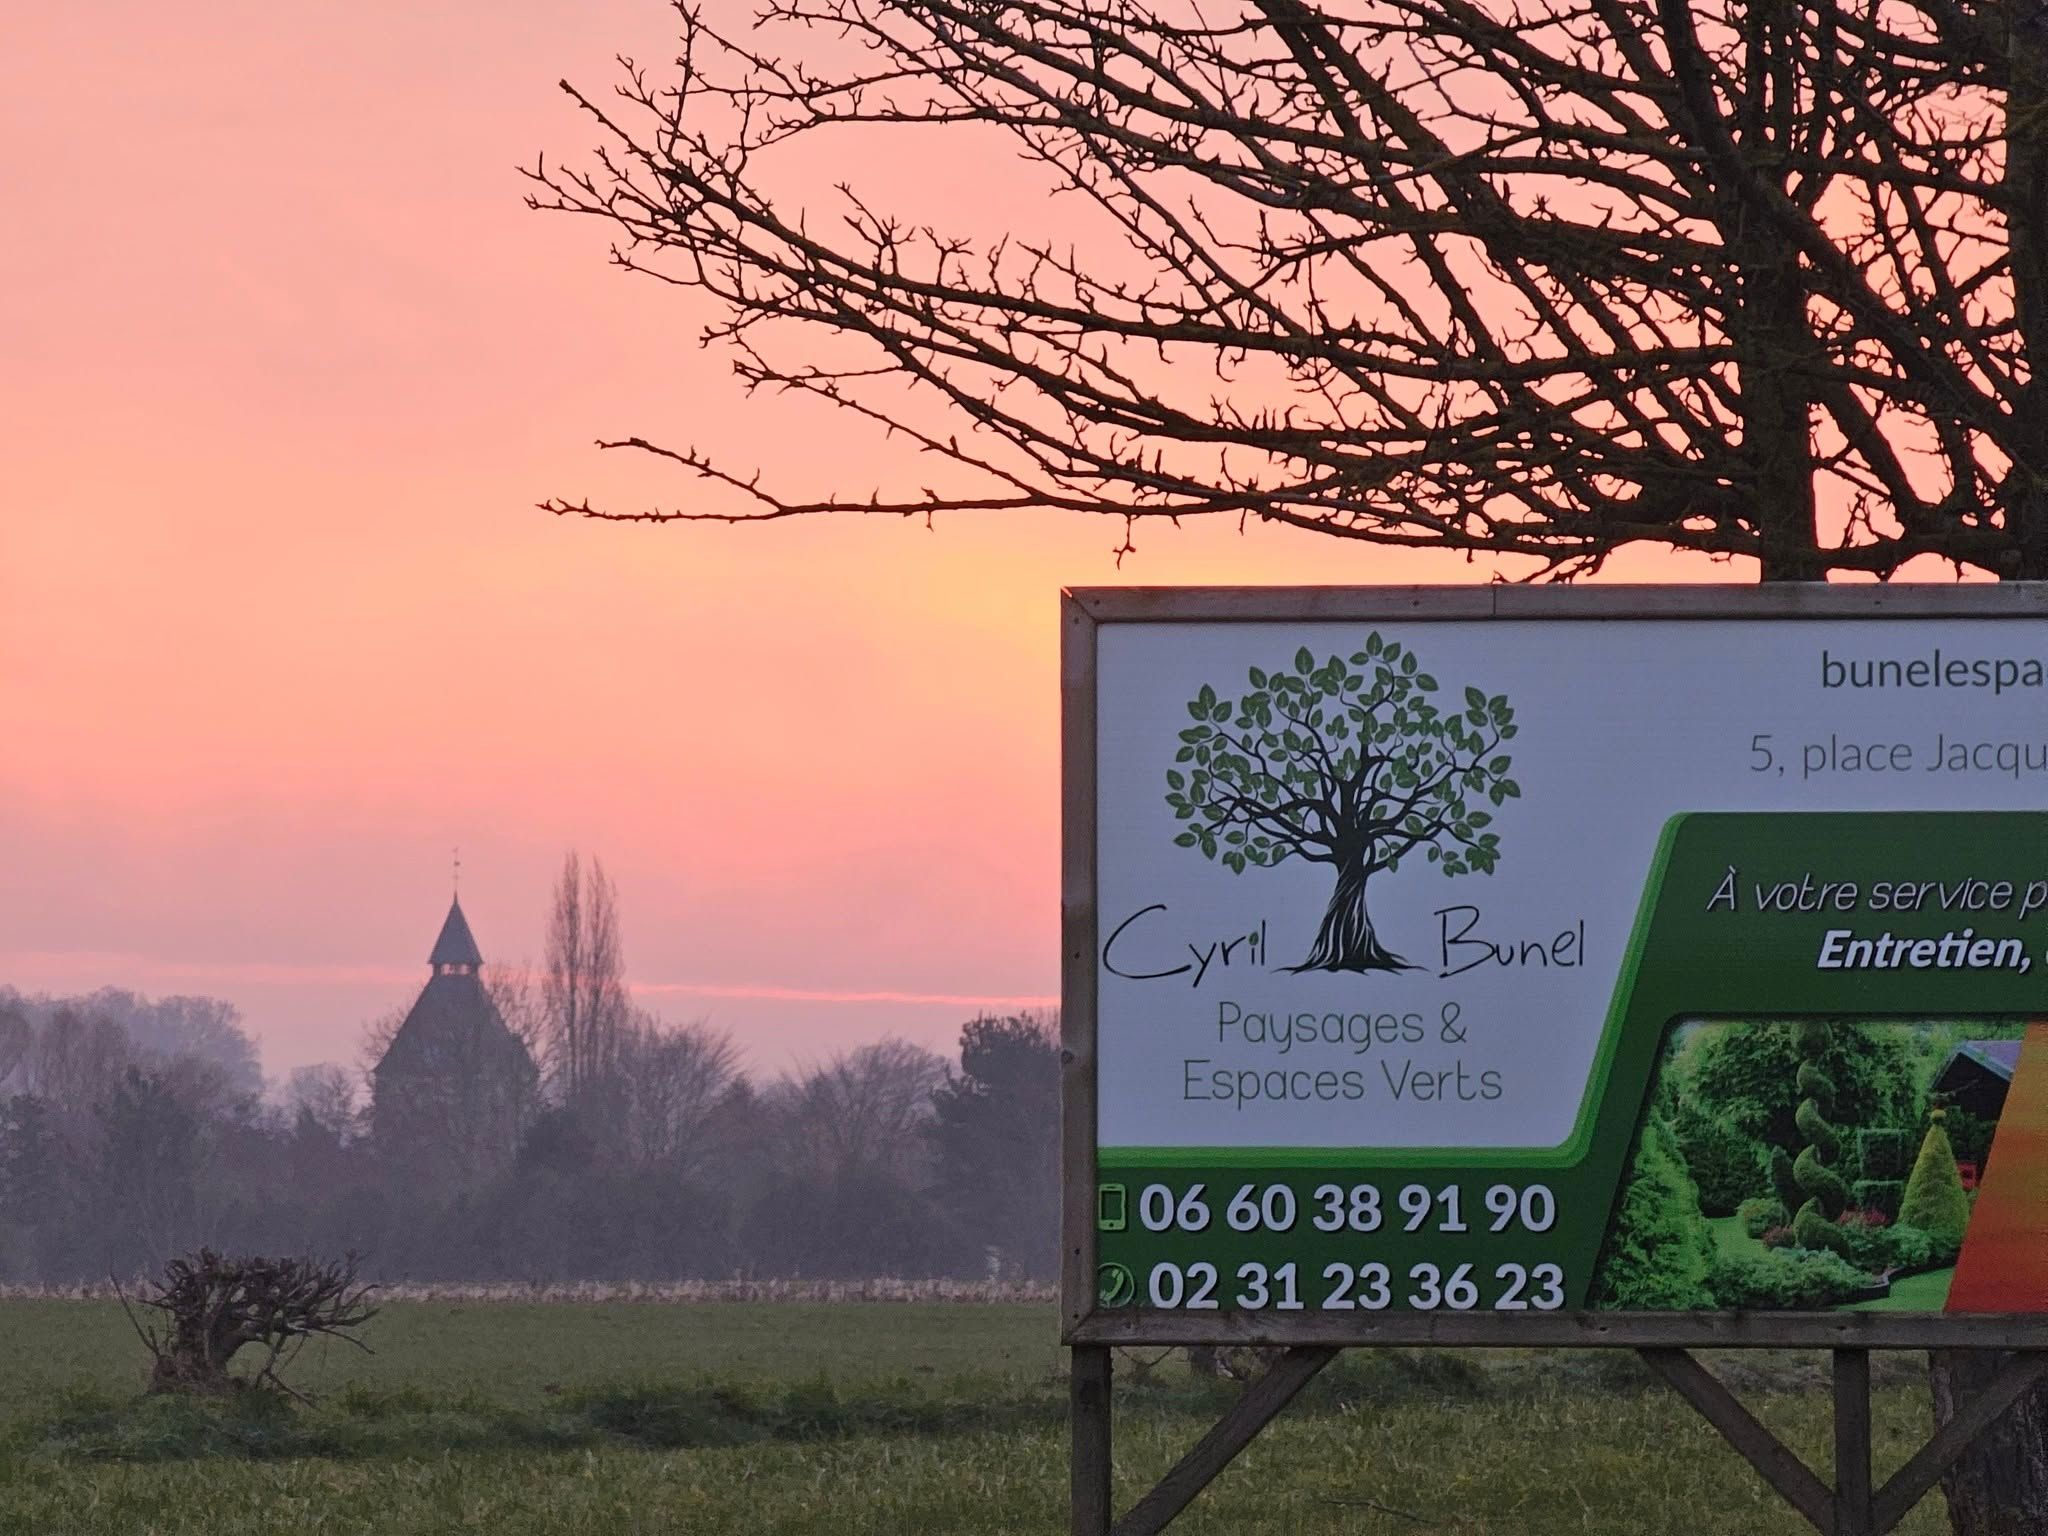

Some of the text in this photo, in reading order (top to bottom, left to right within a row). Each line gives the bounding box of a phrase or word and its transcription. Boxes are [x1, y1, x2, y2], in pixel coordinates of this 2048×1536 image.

[1822, 648, 2048, 694] bunelespa
[1750, 734, 1785, 777] 5,
[1803, 734, 1912, 779] place
[1706, 865, 1737, 911] À
[1756, 872, 1858, 911] votre
[1869, 878, 2012, 911] service
[1102, 904, 1585, 987] Cyril Bunel
[1818, 928, 2032, 974] Entretien,
[1218, 1001, 1467, 1053] Paysages &
[1183, 1060, 1503, 1110] Espaces Verts
[1139, 1184, 1555, 1232] 06 60 38 91 90
[1148, 1263, 1565, 1310] 02 31 23 36 23
